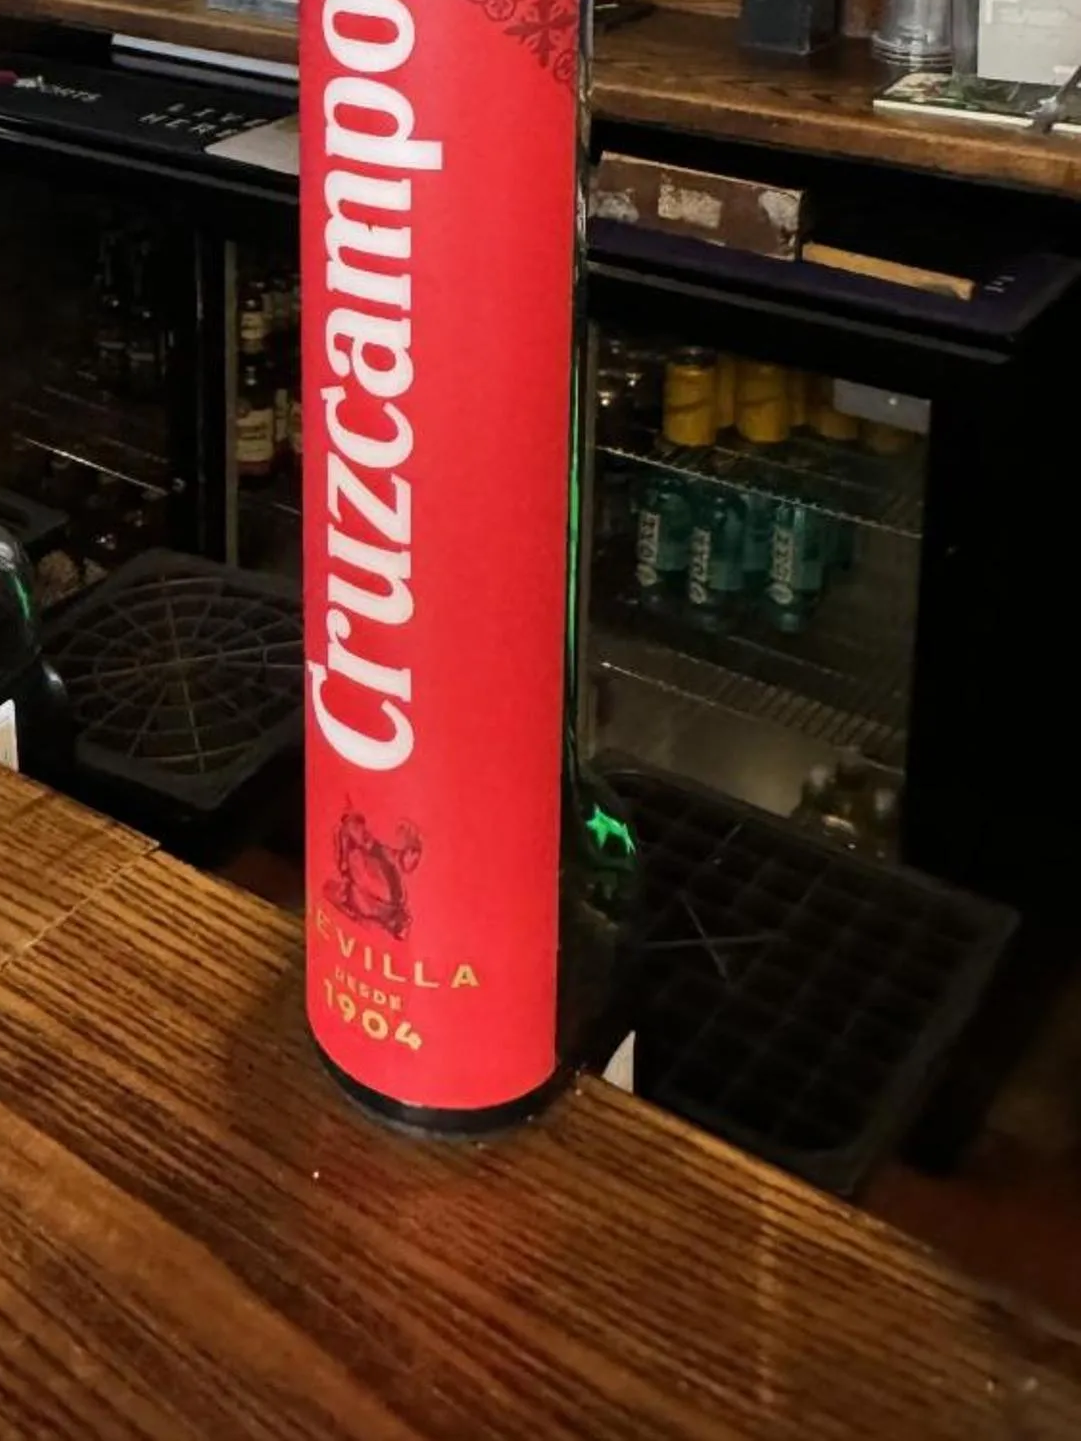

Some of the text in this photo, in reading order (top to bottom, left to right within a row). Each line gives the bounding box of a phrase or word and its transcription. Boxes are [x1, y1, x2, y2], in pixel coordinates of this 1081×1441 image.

[314, 906, 480, 988] EVILLA
[324, 978, 422, 1050] 1904
[335, 965, 402, 1011] DESDE
